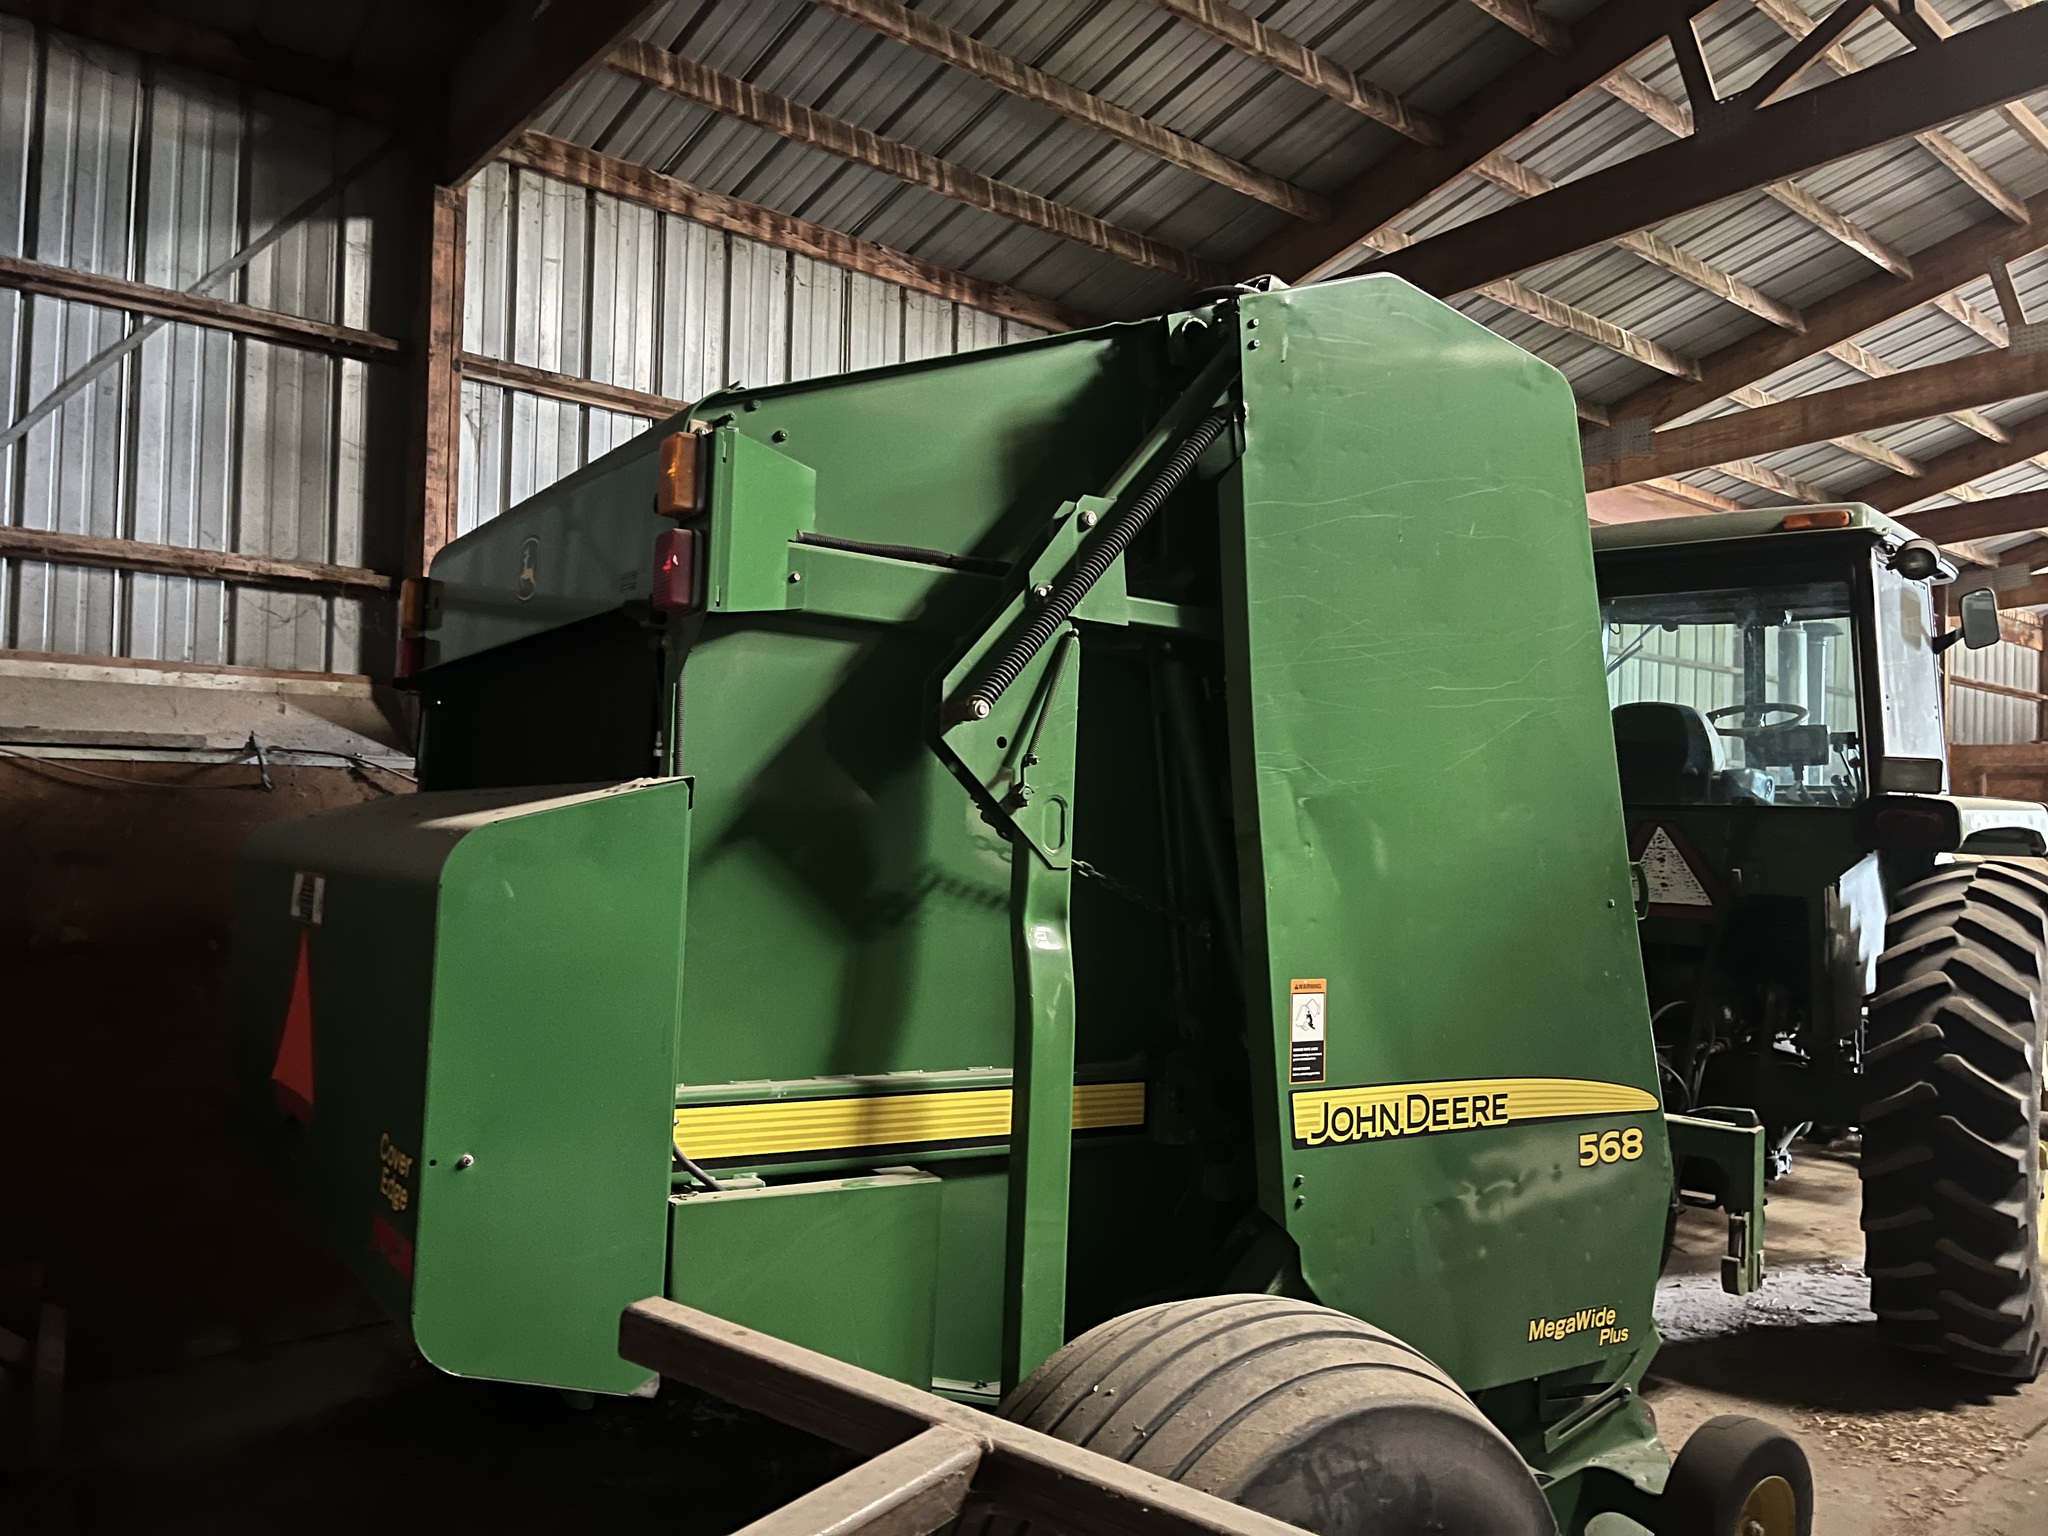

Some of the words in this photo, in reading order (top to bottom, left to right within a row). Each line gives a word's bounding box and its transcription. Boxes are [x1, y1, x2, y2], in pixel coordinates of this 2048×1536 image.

[1310, 1102, 1400, 1140] JOHN
[1406, 1093, 1509, 1132] DEERE
[380, 1131, 414, 1179] Cover
[1579, 1128, 1644, 1167] 568
[380, 1165, 409, 1211] Edge
[1528, 1306, 1617, 1341] MegaWide
[1598, 1327, 1630, 1347] Plus
